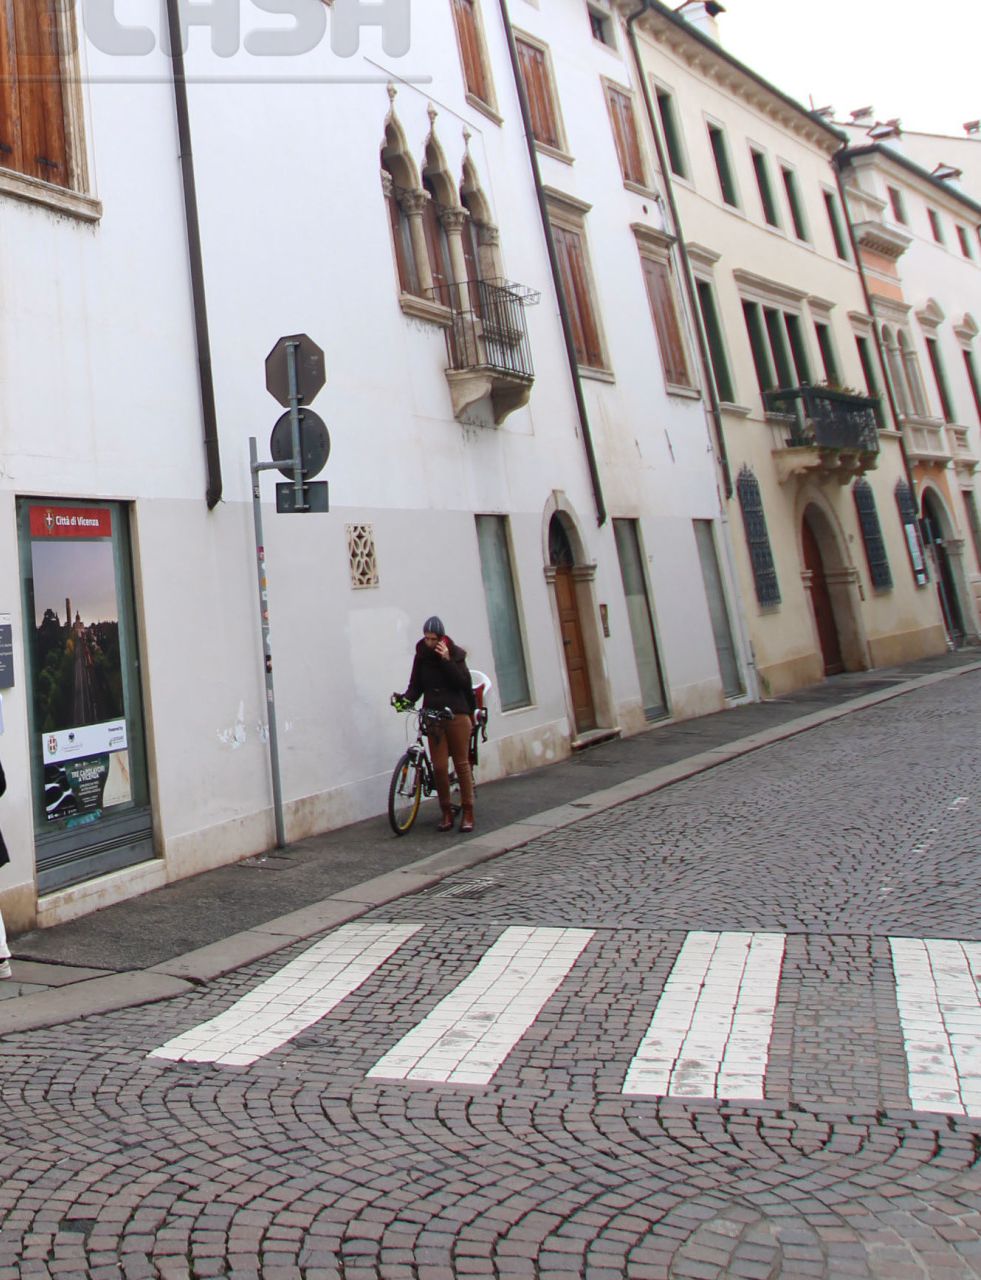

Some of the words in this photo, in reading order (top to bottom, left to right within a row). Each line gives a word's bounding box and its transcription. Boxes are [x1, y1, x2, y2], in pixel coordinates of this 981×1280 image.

[55, 516, 70, 526] Città
[70, 516, 76, 526] di
[77, 516, 99, 527] Vicenza
